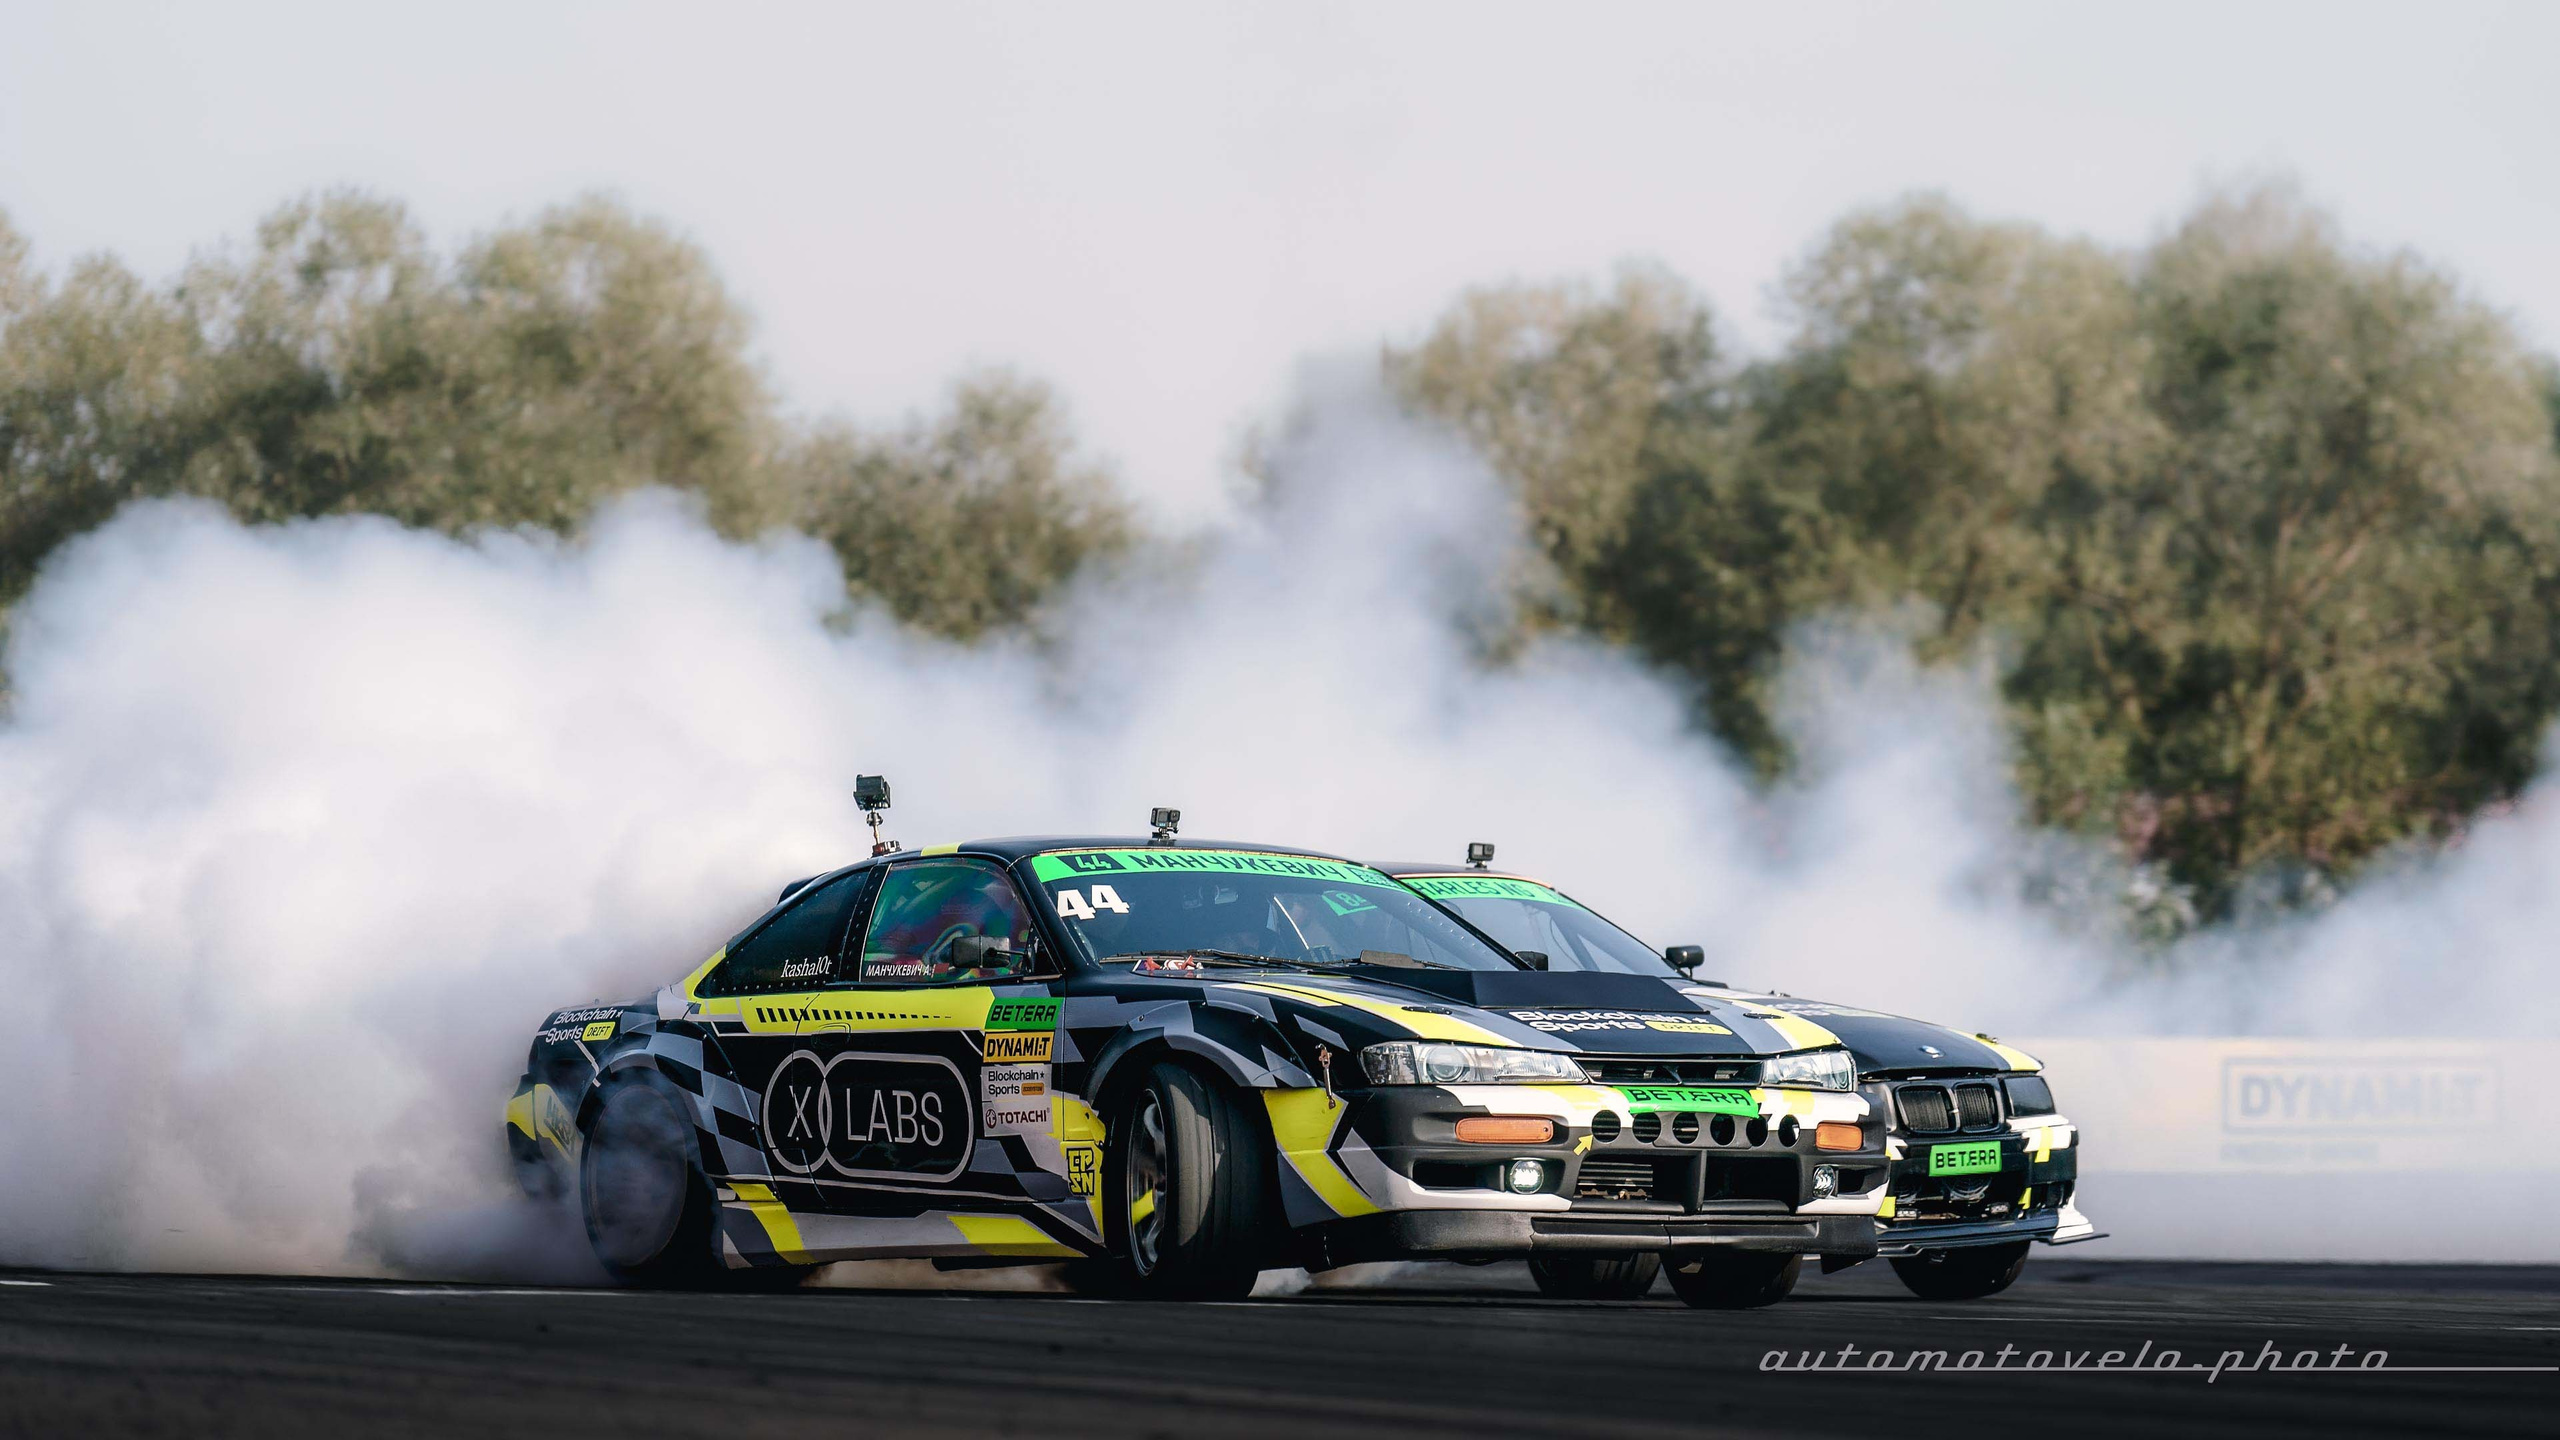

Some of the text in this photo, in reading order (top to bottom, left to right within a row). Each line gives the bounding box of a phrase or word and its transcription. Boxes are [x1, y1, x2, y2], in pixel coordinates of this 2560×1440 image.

[1076, 854, 1112, 871] 44
[1128, 854, 1347, 880] МАНЧУКЕВИЧ
[1406, 881, 1501, 897] HARLES
[1057, 884, 1130, 920] 44
[866, 964, 923, 977] МАНЧУКЕВИЧ
[553, 1007, 616, 1025] Blockchain
[1508, 1010, 1687, 1024] Blockchain
[1529, 1020, 1646, 1033] Sports
[545, 1025, 611, 1045] Sports DRIFT
[988, 1070, 1039, 1082] Blockchain
[988, 1083, 1020, 1097] Sports
[787, 1085, 944, 1146] X LABS
[998, 1110, 1047, 1125] TOTACHI
